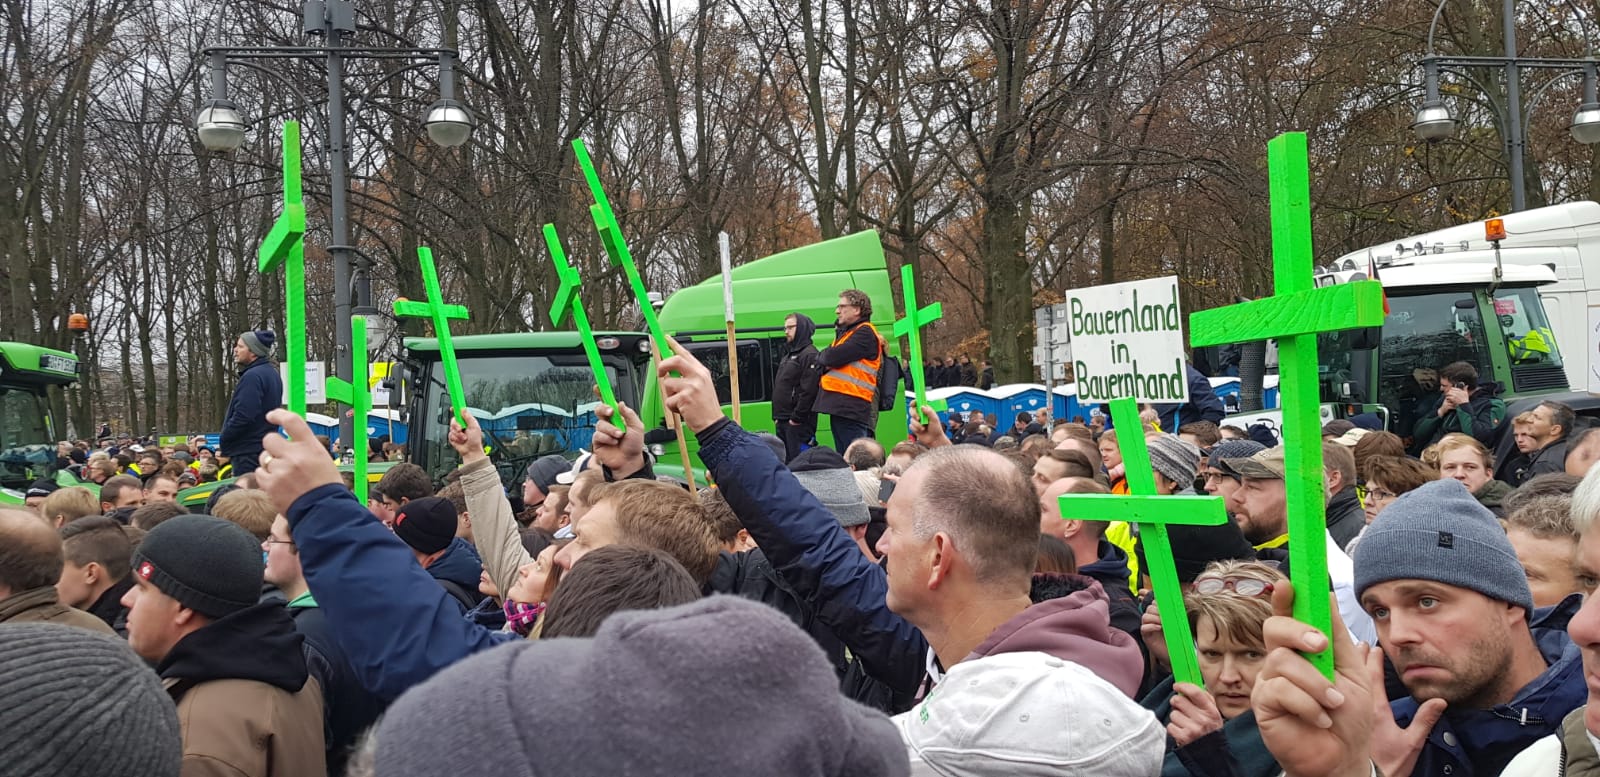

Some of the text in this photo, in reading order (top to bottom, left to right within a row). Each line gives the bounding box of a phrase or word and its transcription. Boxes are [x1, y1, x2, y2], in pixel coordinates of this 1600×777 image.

[1070, 284, 1179, 336] Bauernland
[1110, 339, 1130, 364] in
[1075, 358, 1185, 400] Bauernhand
